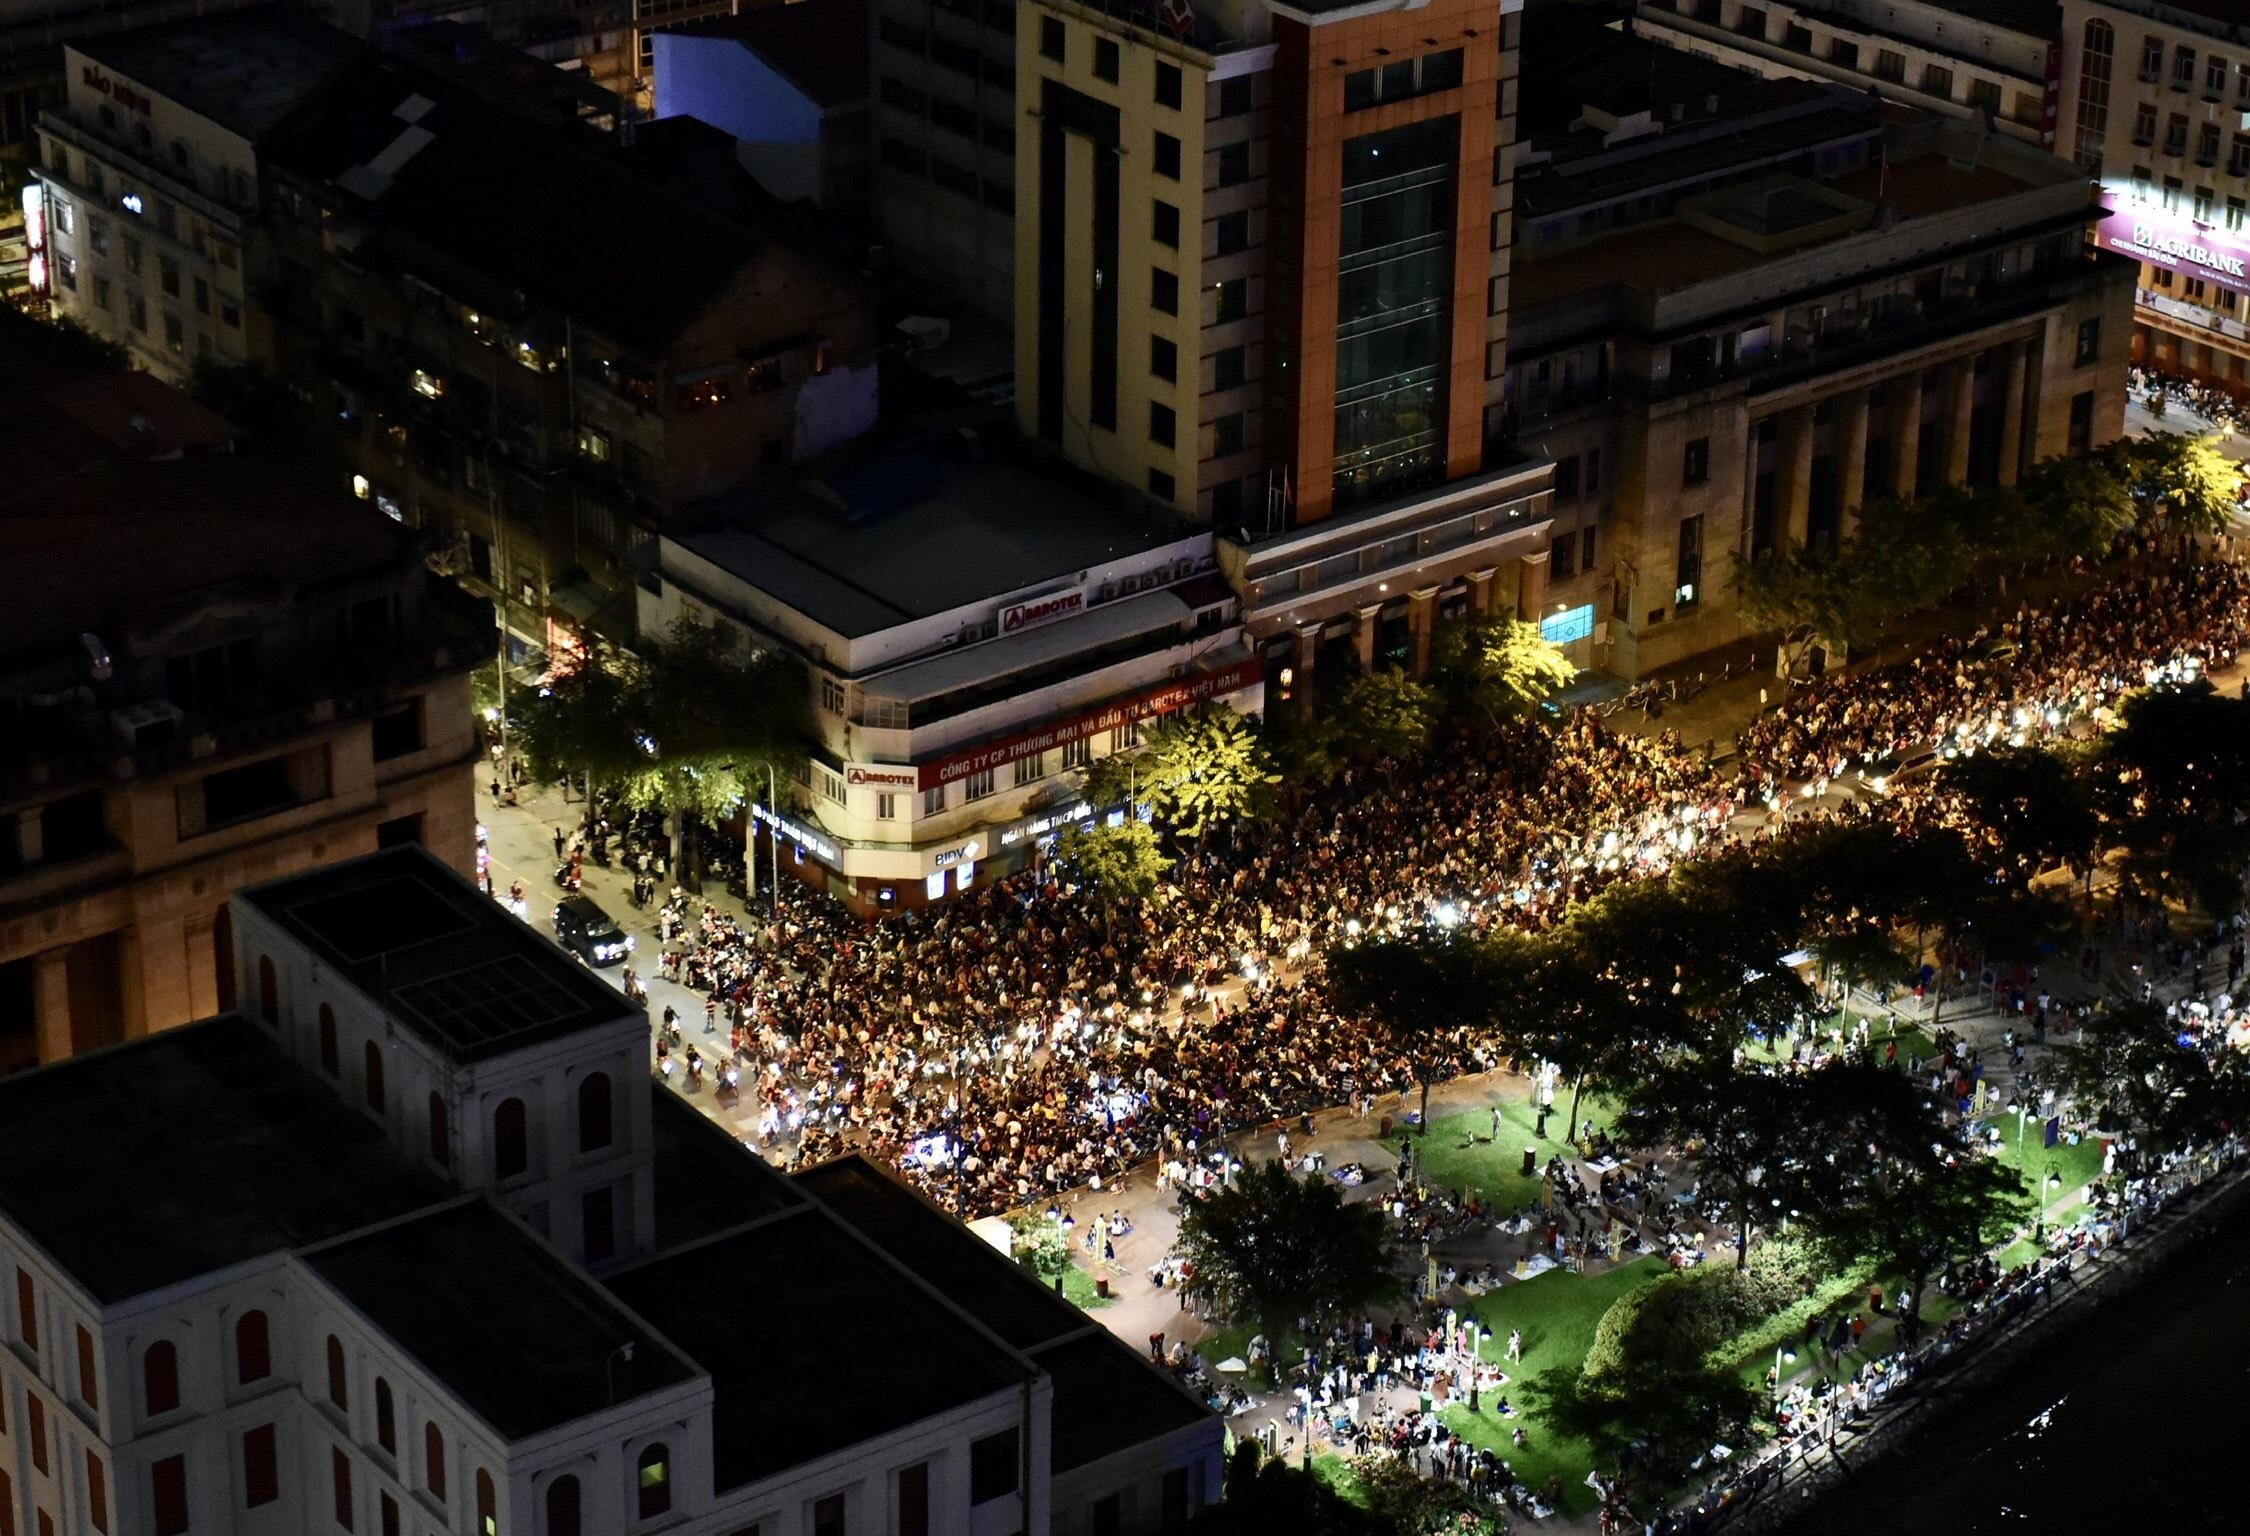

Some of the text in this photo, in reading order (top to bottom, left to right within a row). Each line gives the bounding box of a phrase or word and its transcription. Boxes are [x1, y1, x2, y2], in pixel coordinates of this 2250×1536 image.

[2153, 234, 2245, 277] AGRIBANK
[1025, 592, 1082, 620] BAROTEX
[940, 760, 970, 780] CÔNG
[974, 754, 988, 769] TY
[990, 749, 1005, 764] CP
[1009, 735, 1053, 757] THƯƠNG
[1057, 727, 1078, 742] MẠI
[1081, 717, 1095, 733] VÀ
[1099, 708, 1121, 728] ĐẦU
[1141, 689, 1190, 714] BAROTEX
[1192, 680, 1214, 697] VIỆT
[1217, 672, 1241, 689] NAM
[865, 773, 915, 785] BAROTEX
[1050, 810, 1074, 827] TMCP
[935, 847, 965, 866] BIDV
